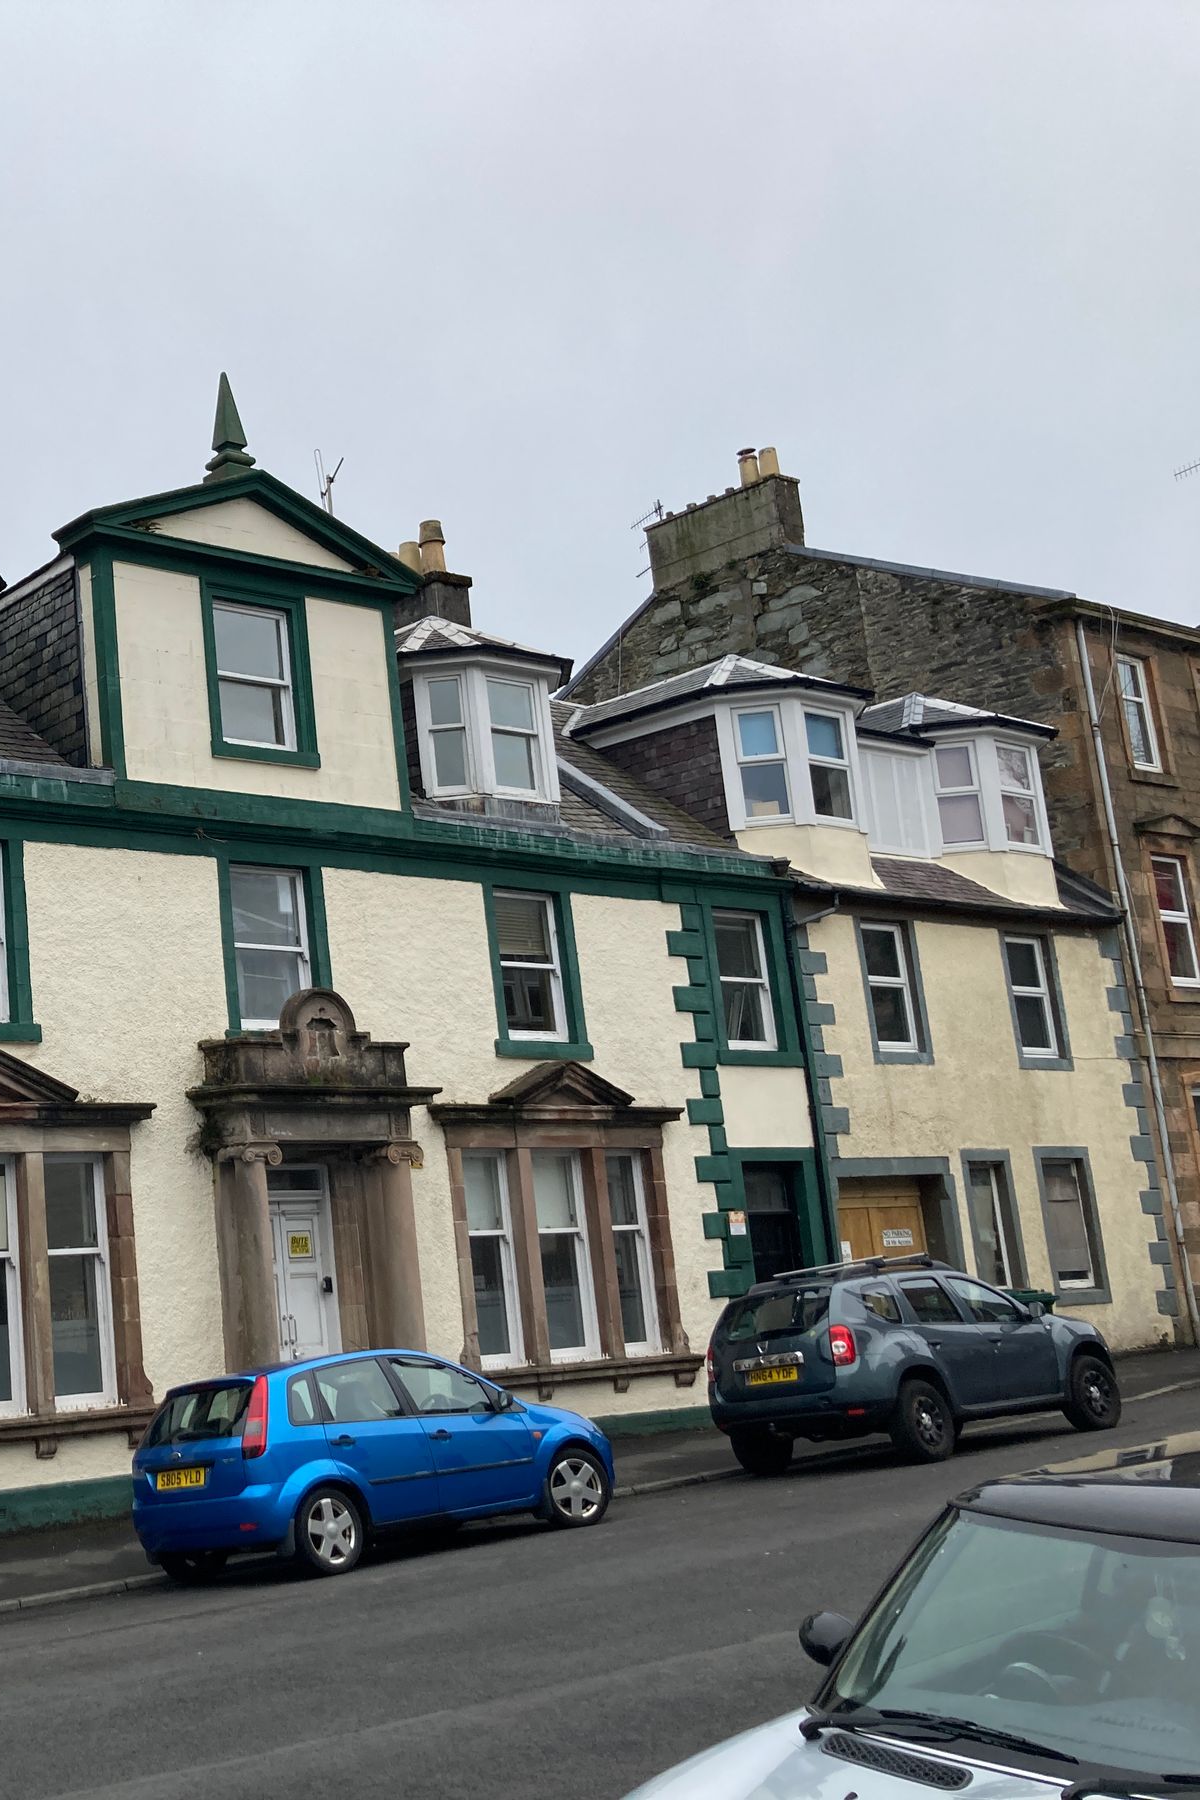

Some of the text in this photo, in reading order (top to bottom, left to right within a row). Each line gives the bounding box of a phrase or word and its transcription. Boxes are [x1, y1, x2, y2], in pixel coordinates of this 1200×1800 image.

[775, 1367, 794, 1380] YDF
[160, 1470, 201, 1488] SB05 YLD
